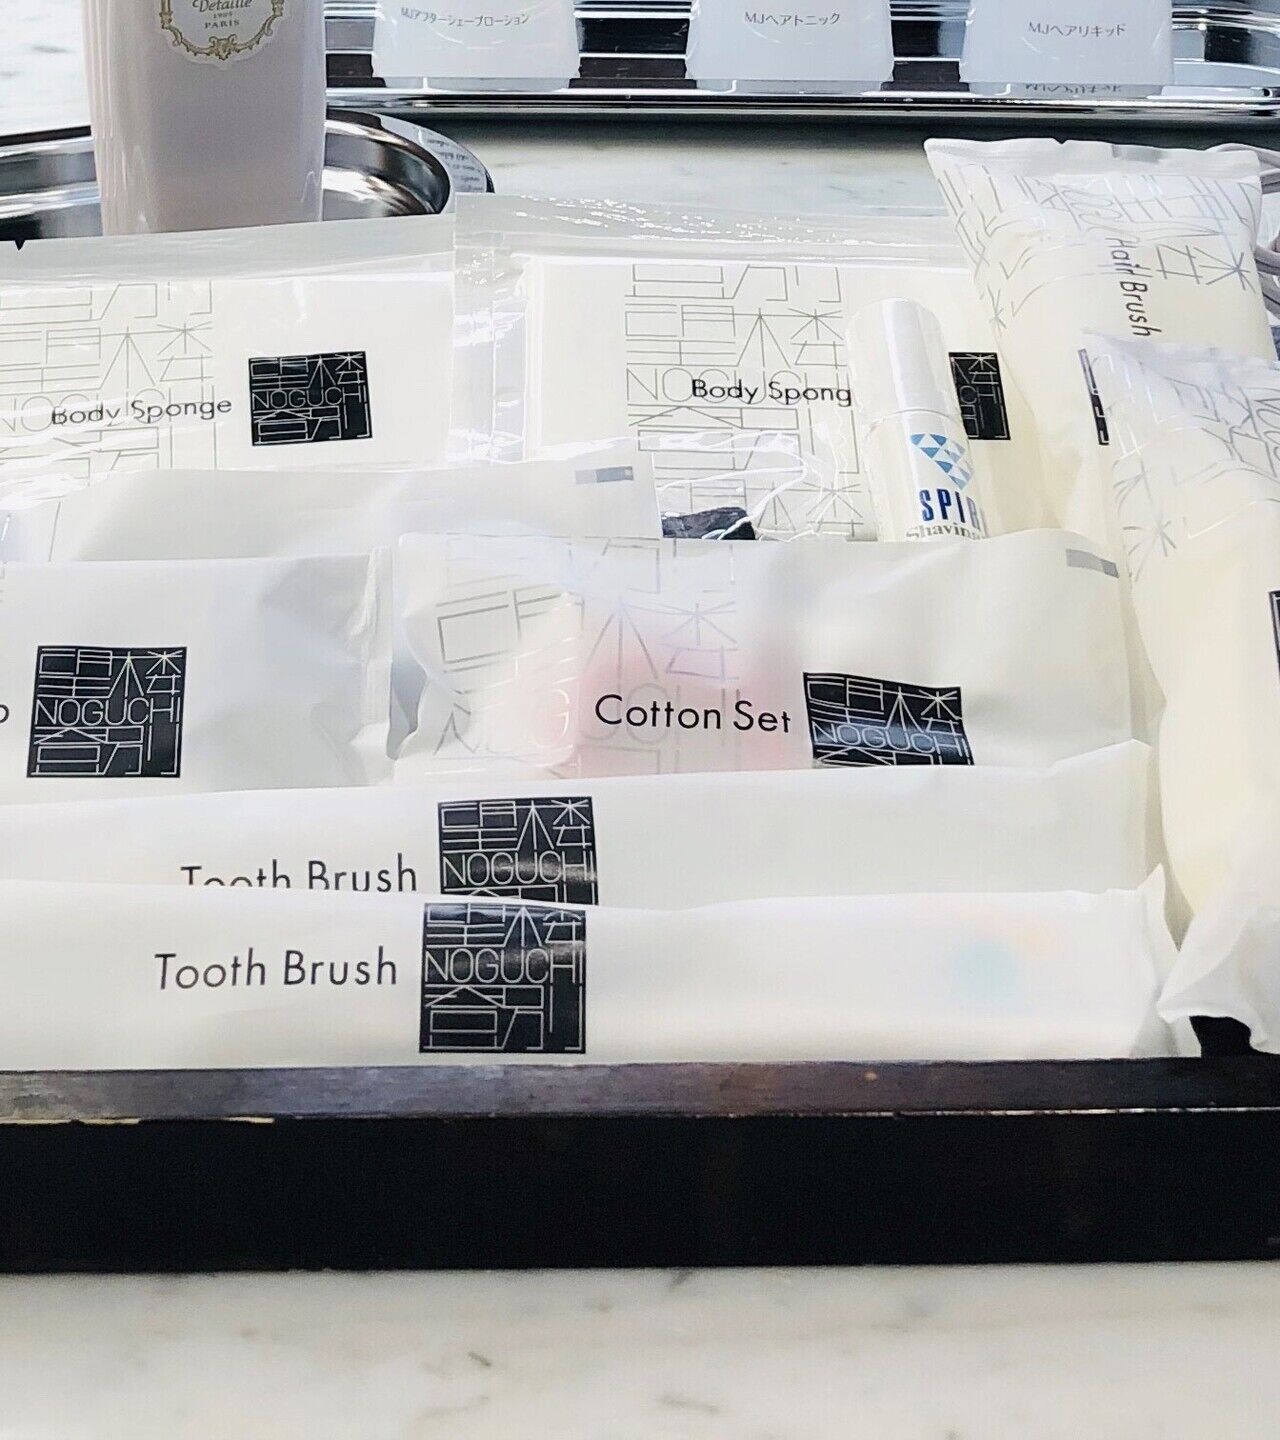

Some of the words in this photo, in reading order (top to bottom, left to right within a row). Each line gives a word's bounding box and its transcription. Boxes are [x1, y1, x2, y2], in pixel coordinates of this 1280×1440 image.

[205, 19, 239, 29] PARIS
[744, 11, 841, 27] MJヘアトニック
[1028, 21, 1127, 38] MJヘアリキッド
[1105, 237, 1140, 276] Hair
[1120, 281, 1162, 336] Brush
[252, 384, 367, 410] NOGUCHI
[692, 379, 758, 405] Body
[768, 380, 852, 407] Spong
[52, 402, 121, 427] Body
[131, 399, 232, 425] Sponge
[35, 697, 181, 726] NOGUCHI
[595, 695, 721, 729] Cotton
[733, 701, 792, 734] Set
[812, 721, 970, 757] NOGUCHI
[308, 853, 417, 892] Brush
[442, 851, 596, 887] NOGUCHI
[155, 947, 266, 991] Tooth
[283, 946, 397, 986] Brush
[424, 948, 586, 985] NOGUCHI
